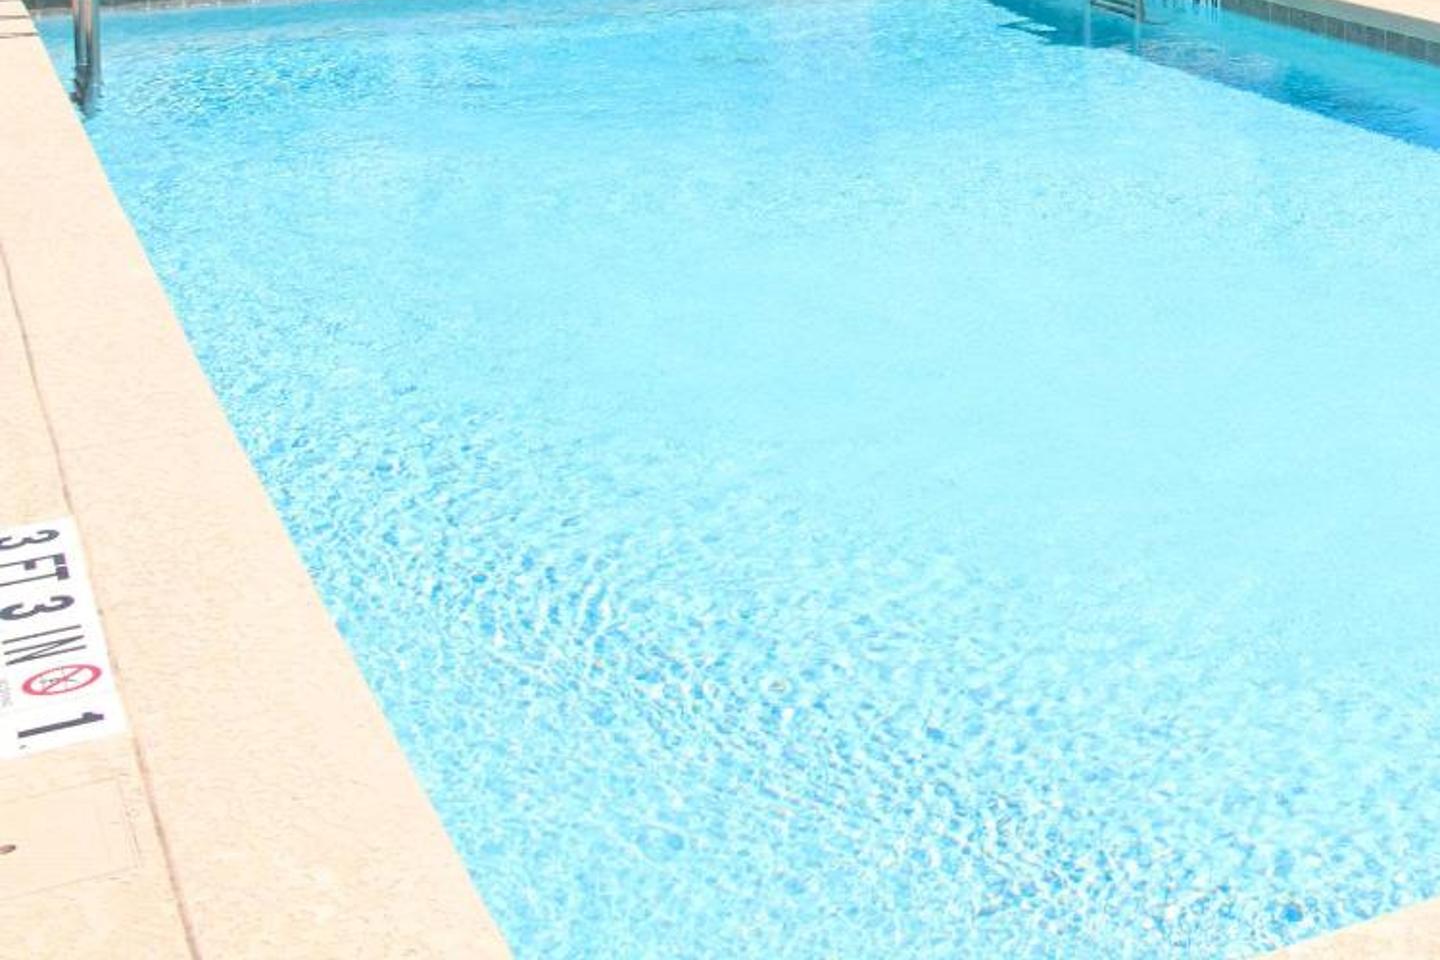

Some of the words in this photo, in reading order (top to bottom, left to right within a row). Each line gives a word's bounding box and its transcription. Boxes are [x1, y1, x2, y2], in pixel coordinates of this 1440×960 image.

[0, 528, 60, 551] 3
[0, 552, 70, 587] FT
[0, 594, 75, 621] 3
[2, 624, 87, 666] IN
